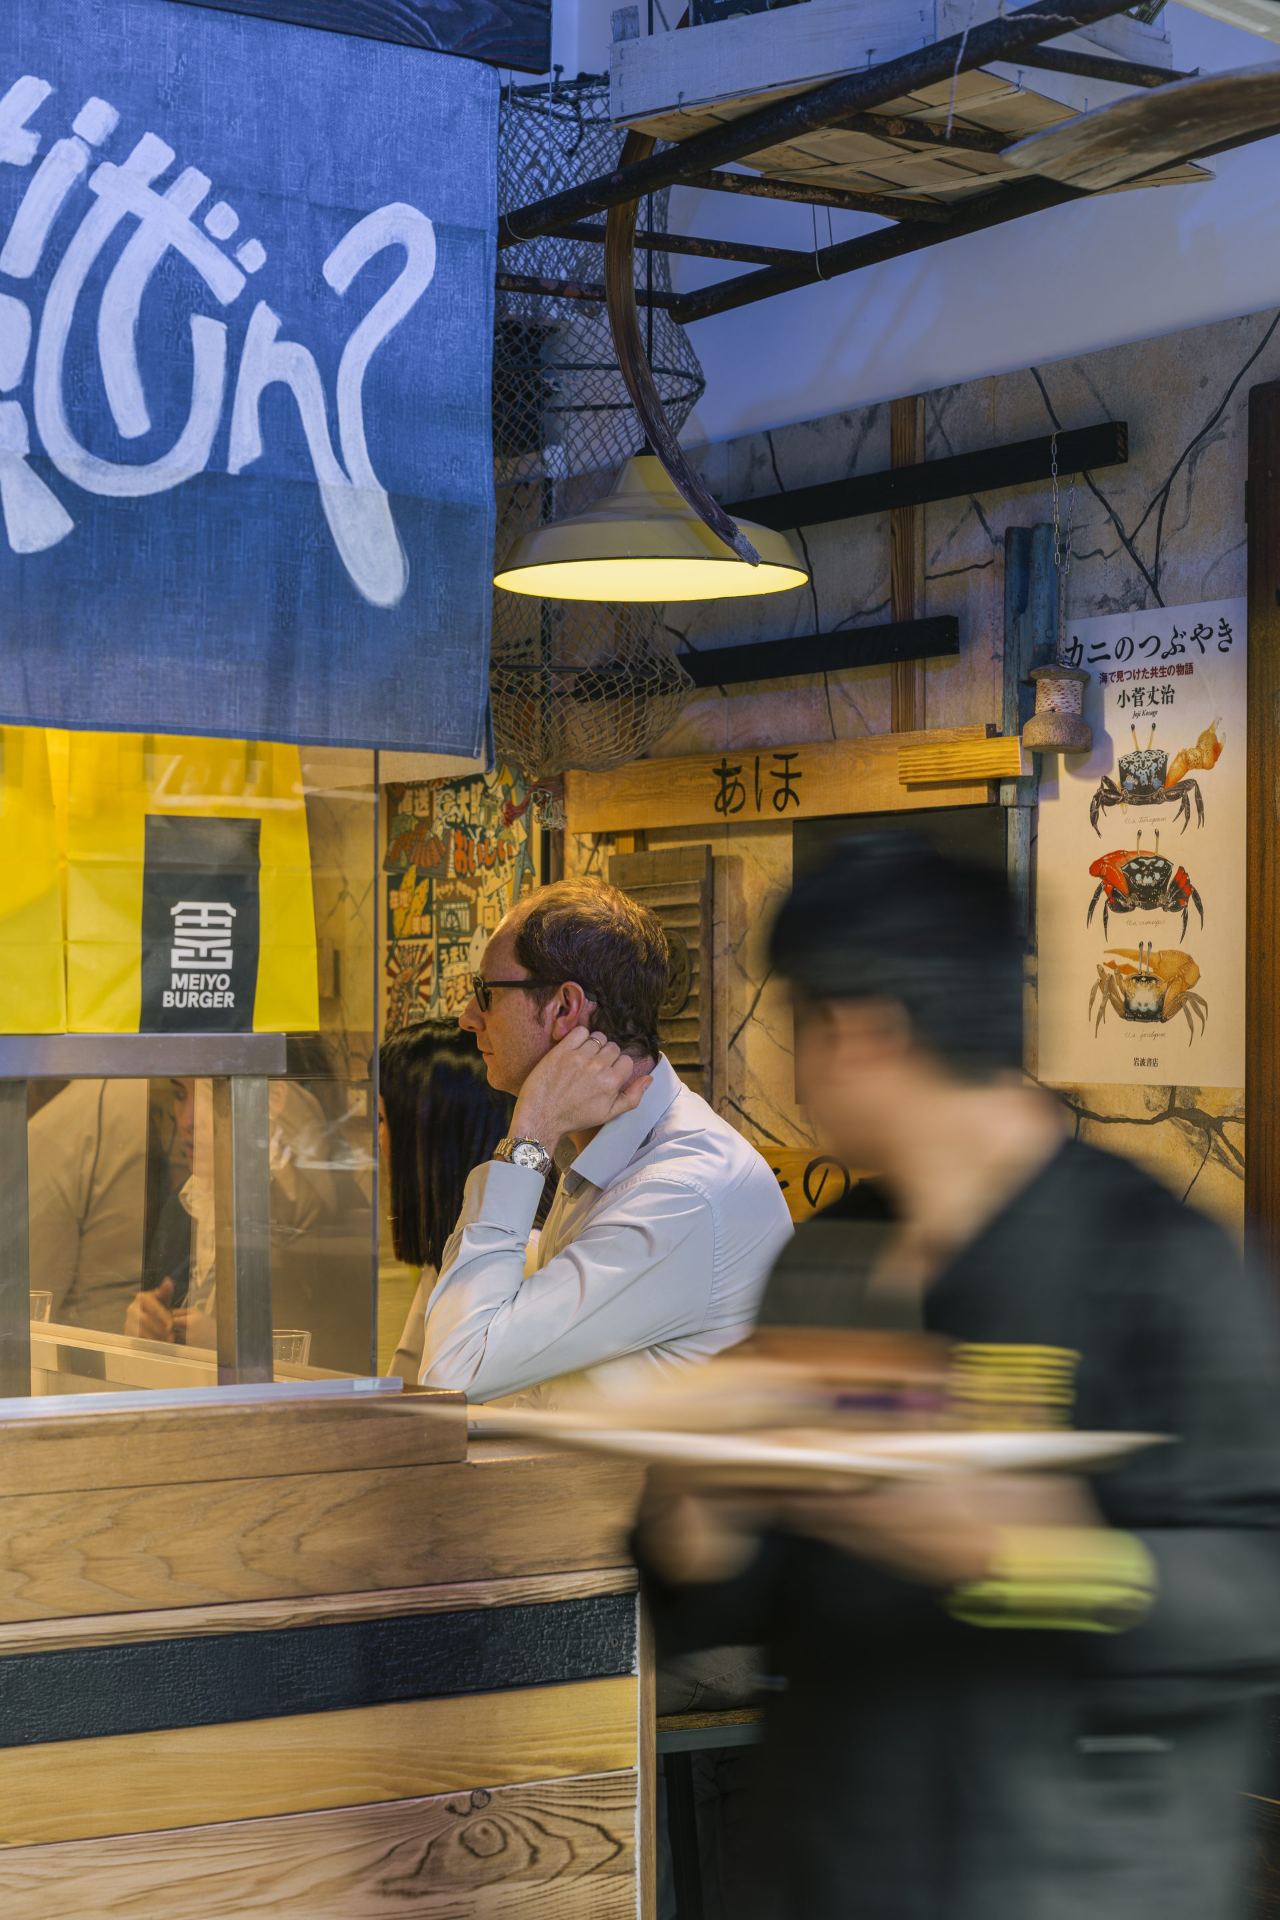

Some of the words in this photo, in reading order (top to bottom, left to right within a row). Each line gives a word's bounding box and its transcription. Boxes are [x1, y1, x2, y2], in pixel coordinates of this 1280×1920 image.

[1065, 617, 1233, 668] カニのつぶやき
[1099, 662, 1194, 684] 海で見つけた共生の物語
[1117, 684, 1175, 708] 小菅丈治
[712, 752, 802, 816] あほ
[171, 973, 231, 990] MEIYO
[162, 991, 235, 1008] BURGER
